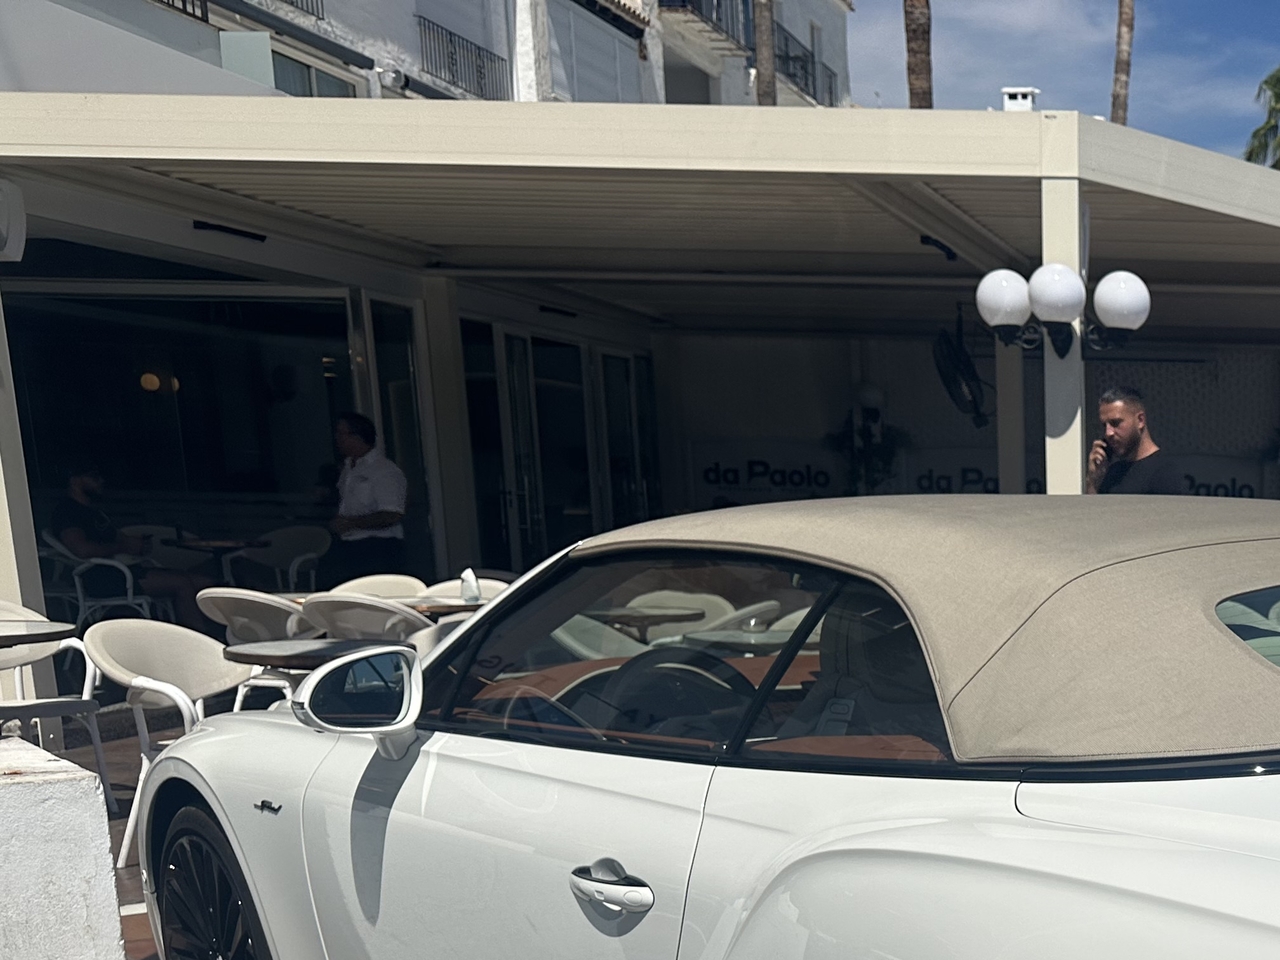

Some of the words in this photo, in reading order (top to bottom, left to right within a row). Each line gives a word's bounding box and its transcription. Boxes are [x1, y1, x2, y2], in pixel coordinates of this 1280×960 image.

[704, 462, 740, 485] da
[746, 460, 830, 488] Paolo
[917, 468, 952, 493] da
